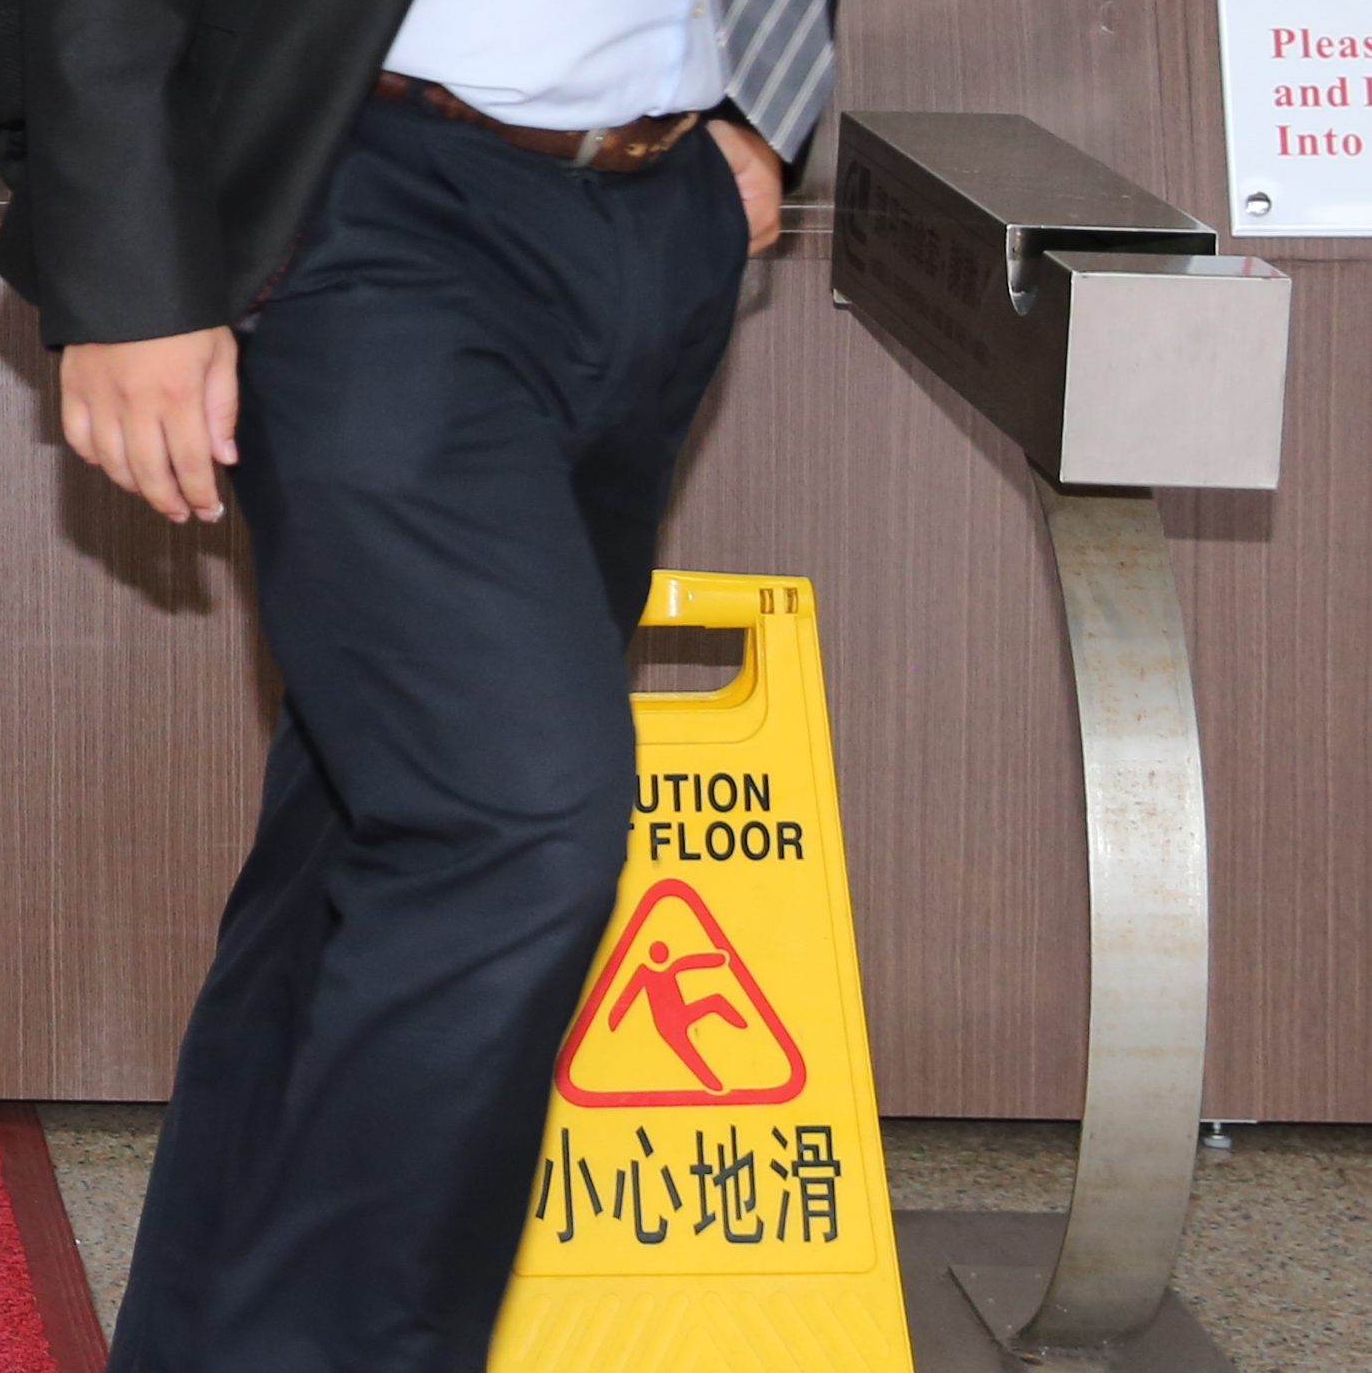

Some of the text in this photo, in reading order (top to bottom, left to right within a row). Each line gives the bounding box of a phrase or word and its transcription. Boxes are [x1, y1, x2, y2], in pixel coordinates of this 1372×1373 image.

[1273, 76, 1350, 107] and
[1275, 124, 1363, 156] Into
[649, 820, 804, 862] FLOOR
[535, 1124, 841, 1245] 小心地滑
